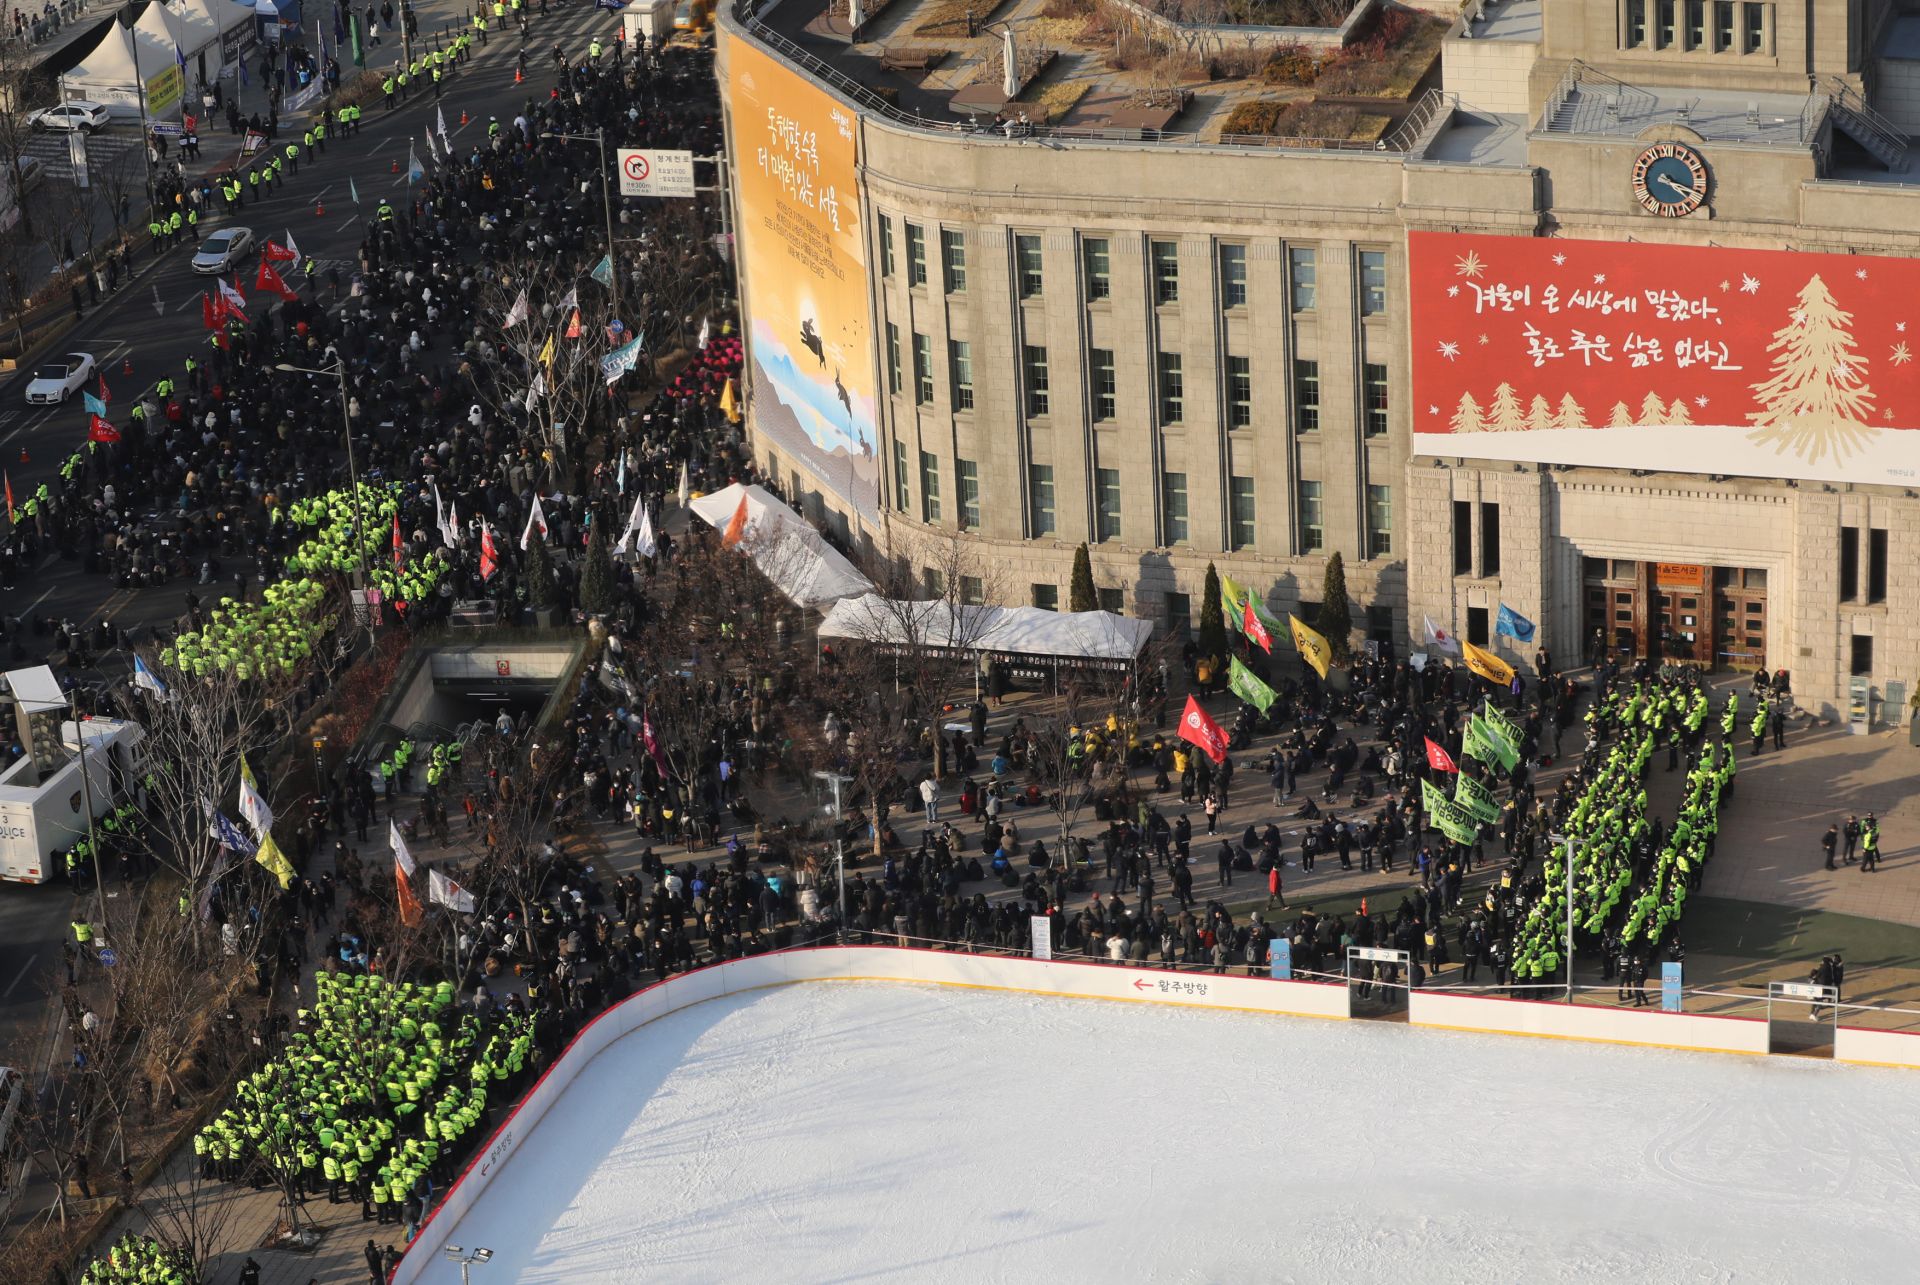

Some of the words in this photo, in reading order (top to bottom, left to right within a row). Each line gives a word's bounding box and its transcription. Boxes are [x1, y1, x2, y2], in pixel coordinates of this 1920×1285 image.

[657, 155, 690, 163] 청계천로
[757, 148, 768, 177] 더
[819, 185, 840, 232] 서울
[1466, 281, 1530, 314] 겨울이
[1541, 283, 1560, 314] 온
[1567, 288, 1637, 315] 세상에
[1522, 321, 1565, 367] 홀로
[1568, 328, 1613, 366] 추운
[1622, 332, 1664, 368] 삶은
[1674, 337, 1743, 371] 없다고
[2, 815, 9, 824] 3
[1158, 979, 1209, 996] 활주방향
